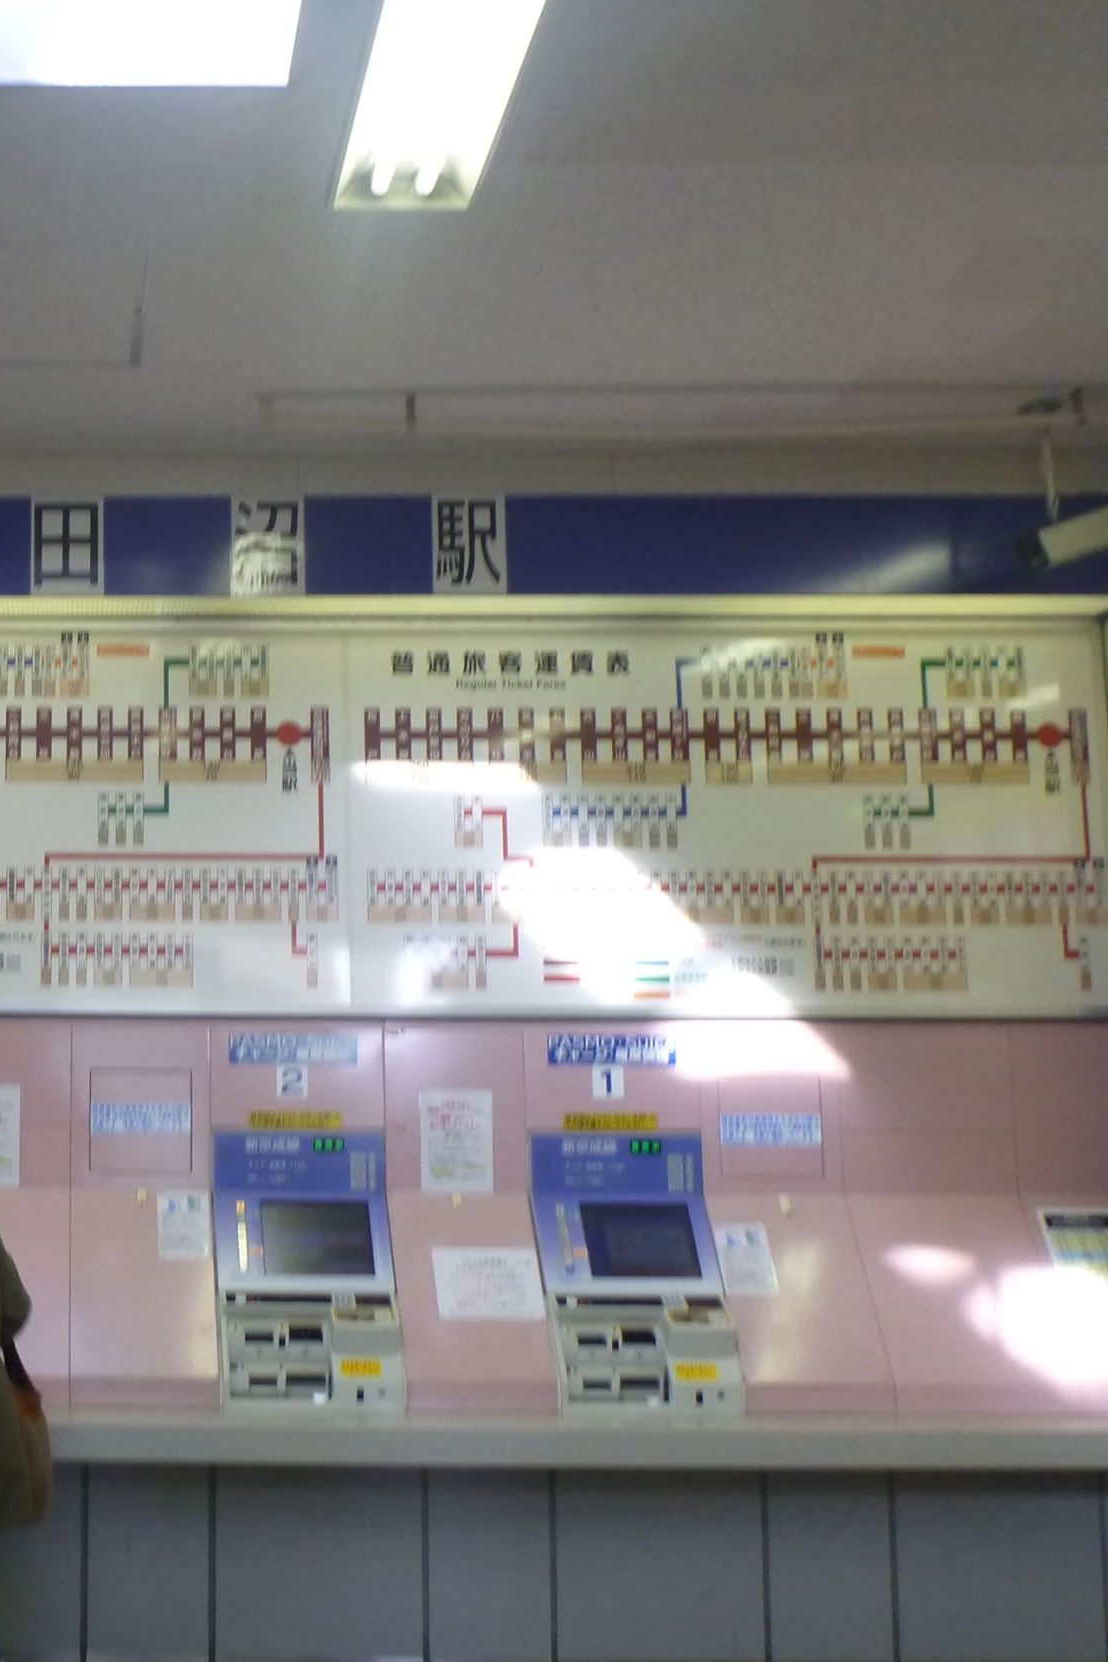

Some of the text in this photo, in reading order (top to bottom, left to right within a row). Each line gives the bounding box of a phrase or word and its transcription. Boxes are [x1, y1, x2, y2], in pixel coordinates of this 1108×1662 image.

[391, 648, 631, 676] 普通旅客運賃表
[281, 1065, 303, 1096] 2
